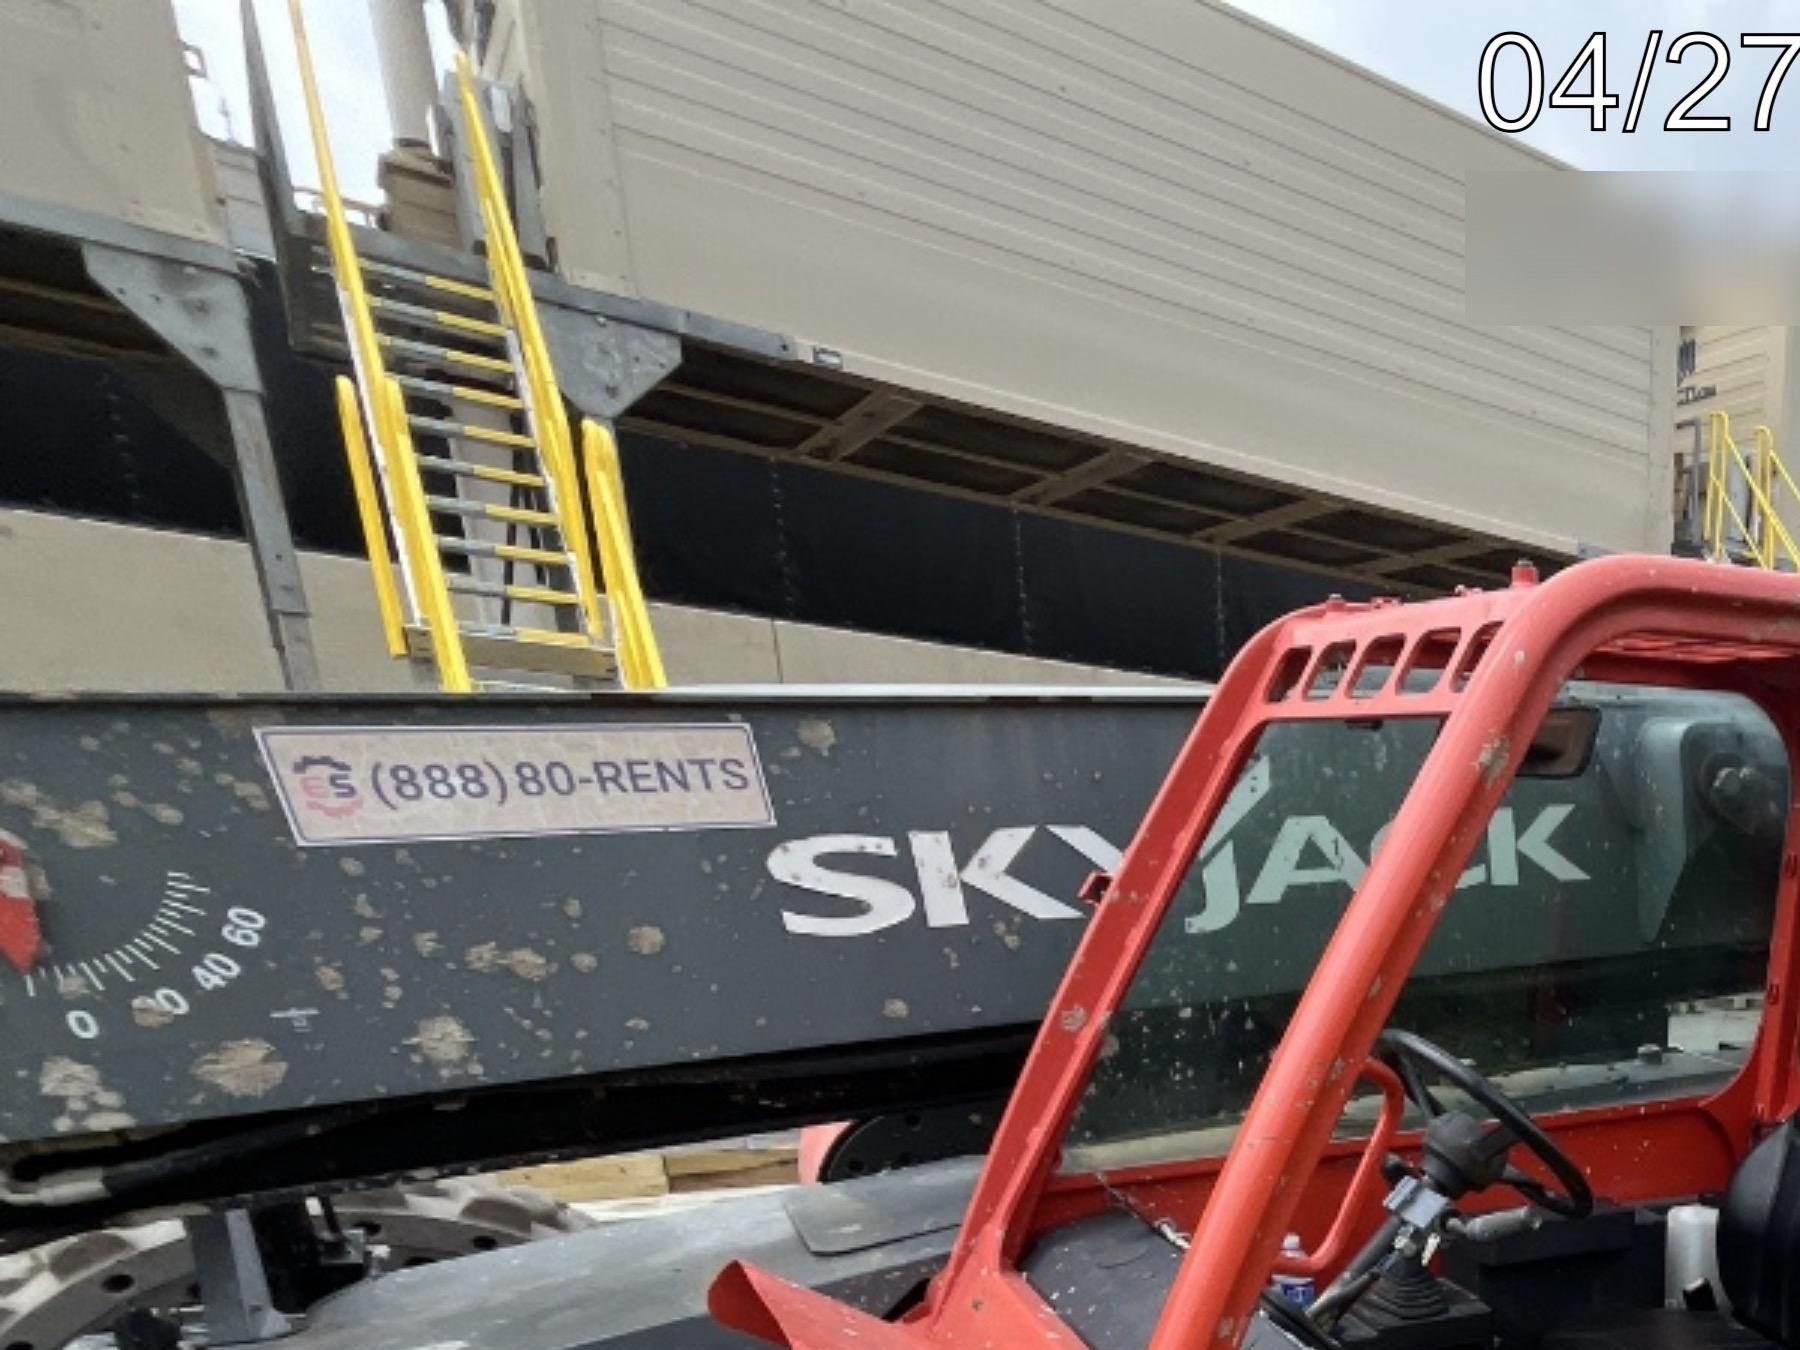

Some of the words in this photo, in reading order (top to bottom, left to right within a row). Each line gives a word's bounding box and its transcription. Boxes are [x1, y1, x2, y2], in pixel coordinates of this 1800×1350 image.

[766, 754, 1590, 937] SKYJAK
[65, 1009, 100, 1039] 0
[191, 952, 242, 991] 40
[221, 905, 267, 948] 60
